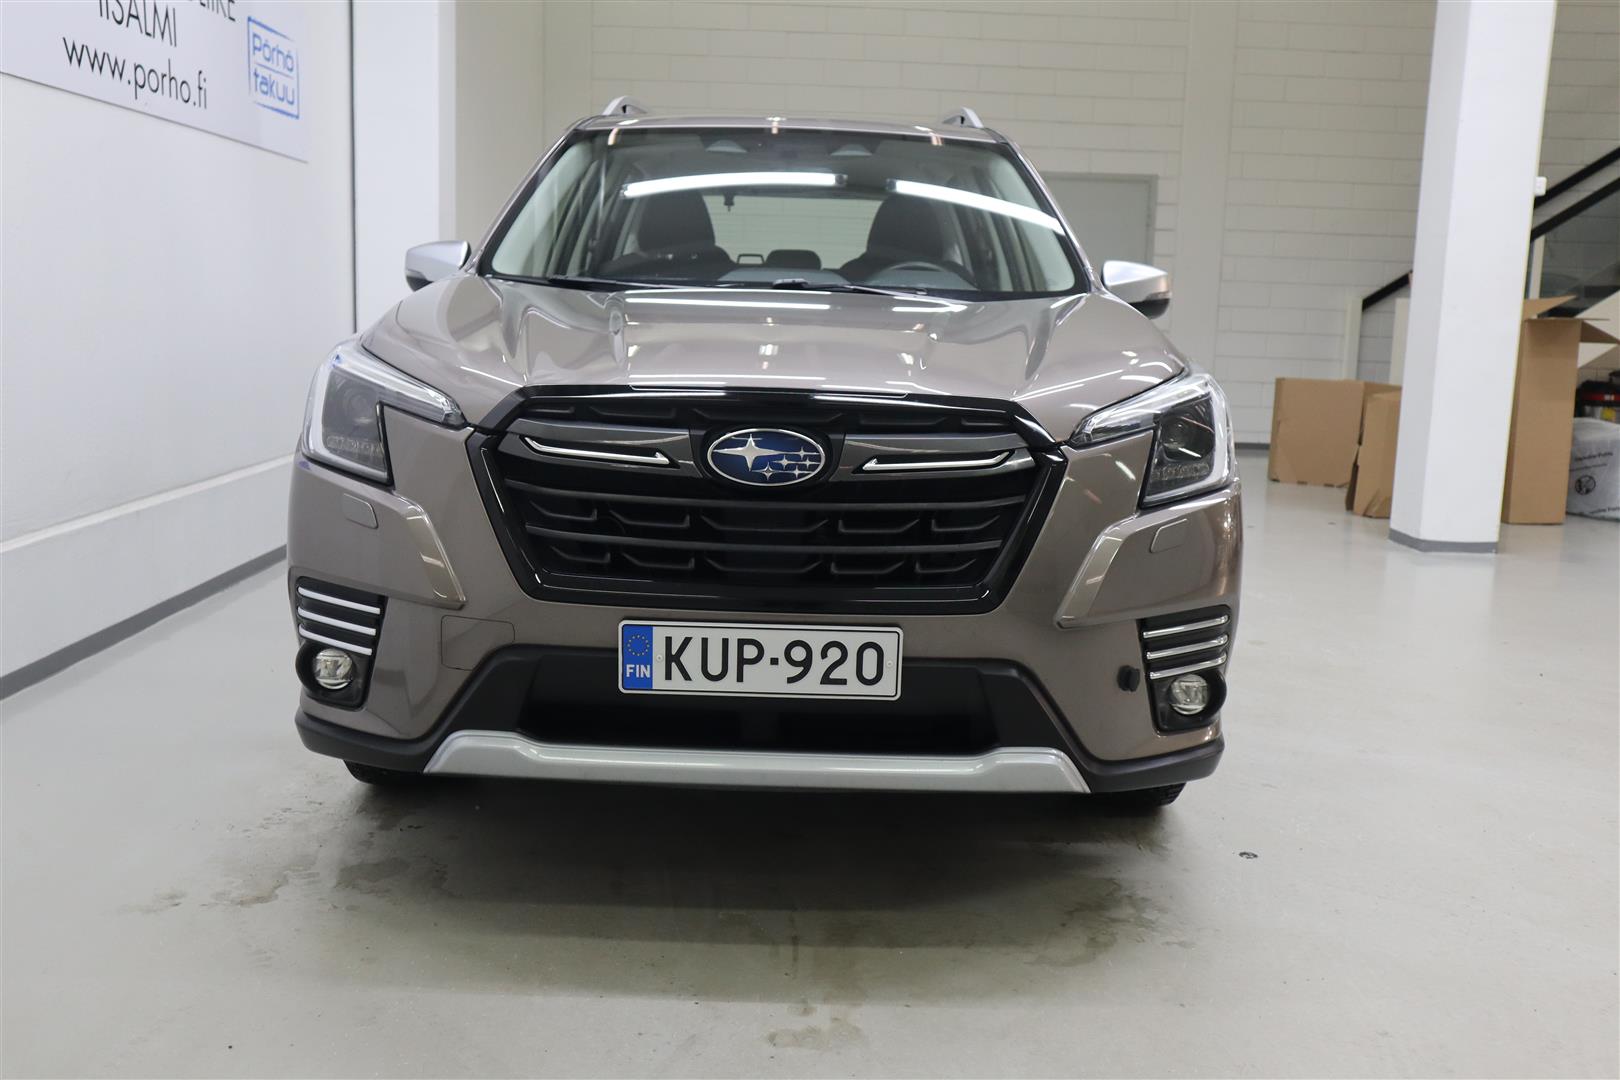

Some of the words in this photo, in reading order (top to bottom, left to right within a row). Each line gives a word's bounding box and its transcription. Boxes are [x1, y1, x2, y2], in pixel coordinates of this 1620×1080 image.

[62, 36, 208, 110] www.porho.fi
[253, 67, 295, 105] takuu
[626, 664, 651, 678] FIN
[664, 636, 885, 686] KUP-920
